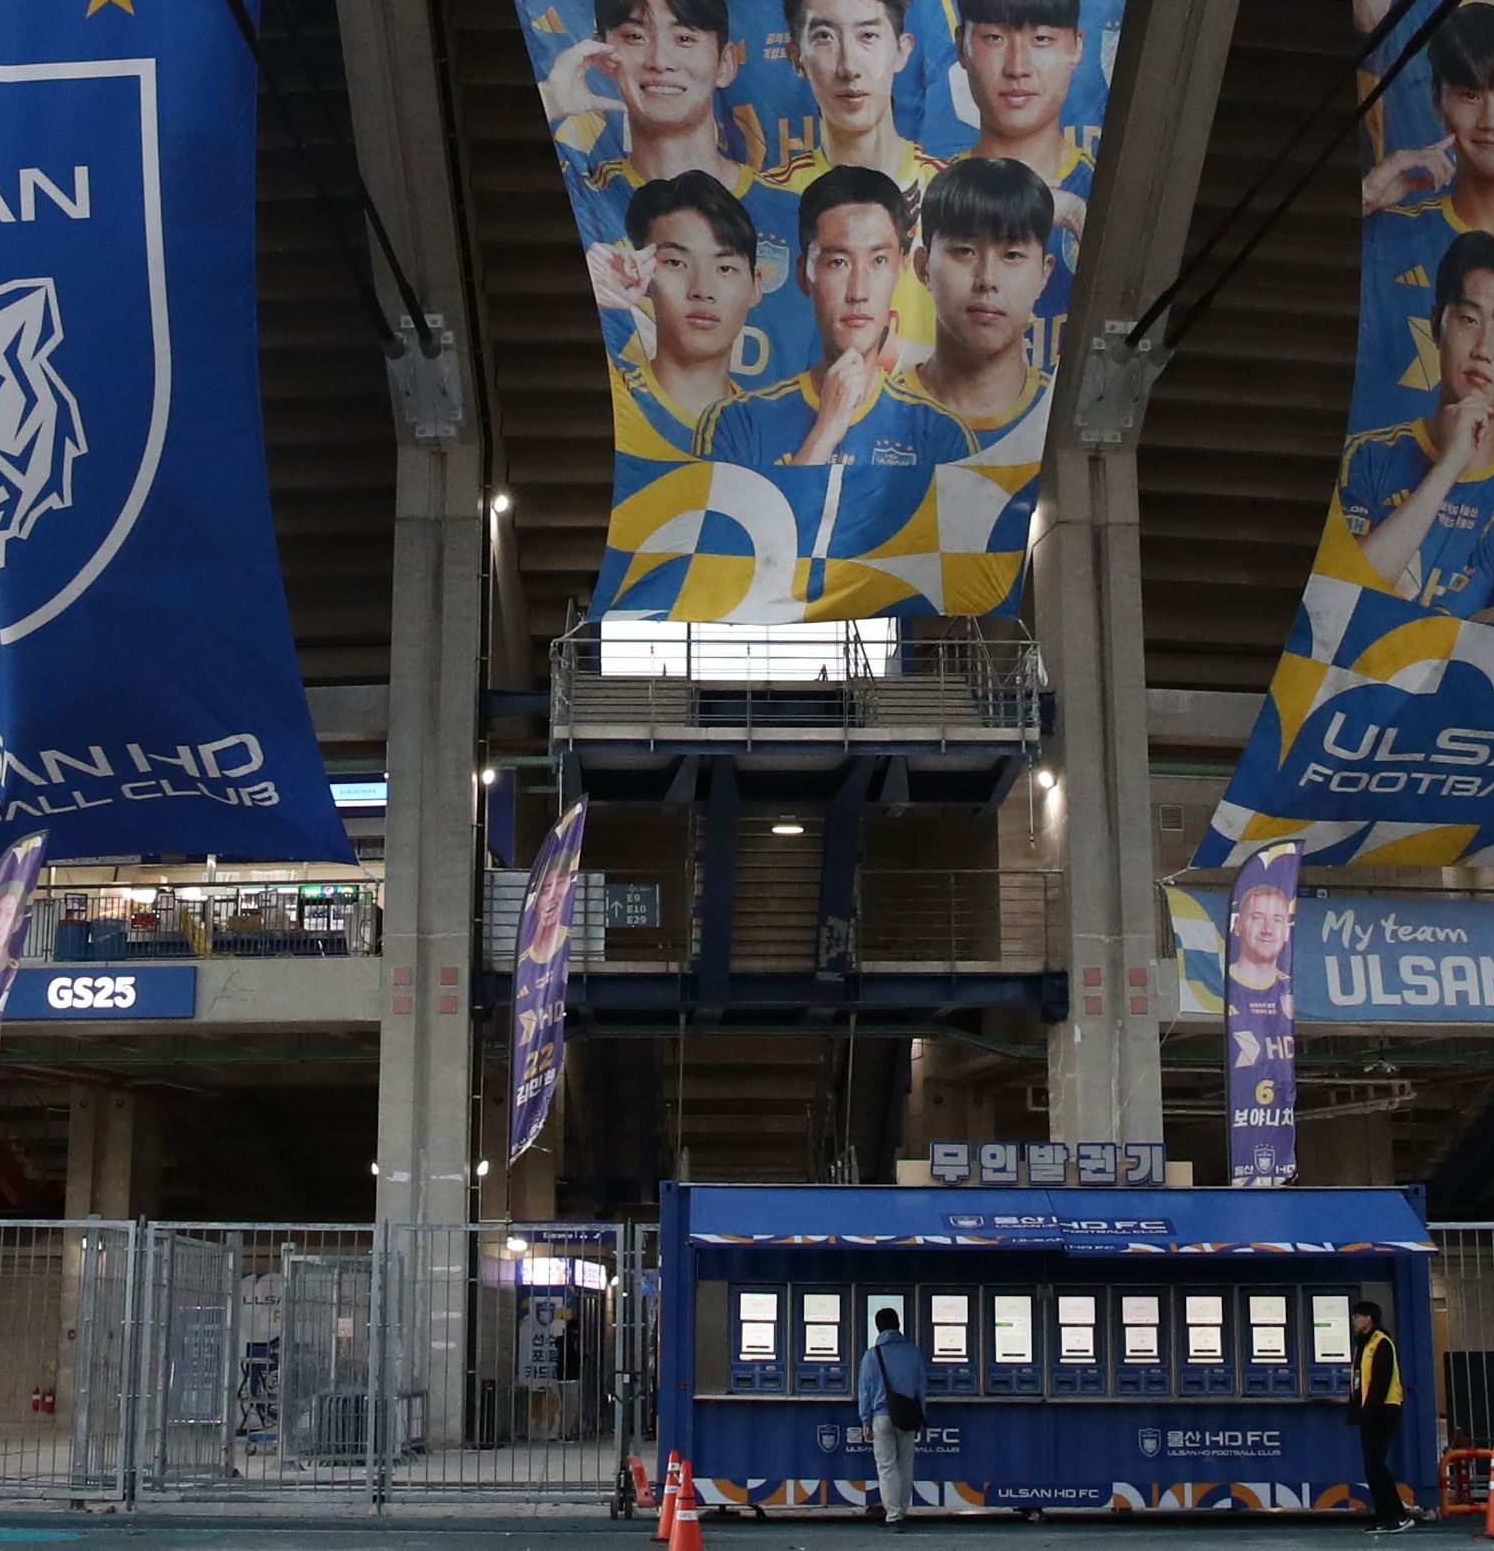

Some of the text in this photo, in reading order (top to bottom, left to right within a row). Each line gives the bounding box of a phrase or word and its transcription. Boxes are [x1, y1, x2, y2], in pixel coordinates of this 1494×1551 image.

[729, 326, 769, 375] D
[126, 733, 263, 779] HD
[121, 781, 280, 807] CLUB
[627, 894, 641, 903] E9
[627, 904, 647, 914] E10
[627, 915, 647, 925] E29
[1322, 909, 1468, 951] My team
[47, 976, 136, 1009] GS25
[537, 1000, 565, 1030] HD
[523, 1042, 555, 1080] 22
[1255, 1080, 1275, 1105] 6
[931, 1142, 1166, 1185] 무인발권기
[1114, 1221, 1166, 1230] FC
[927, 1428, 960, 1443] FC
[1167, 1431, 1280, 1447] 울산 HD FC
[998, 1489, 1099, 1498] ULSAN HD FC
